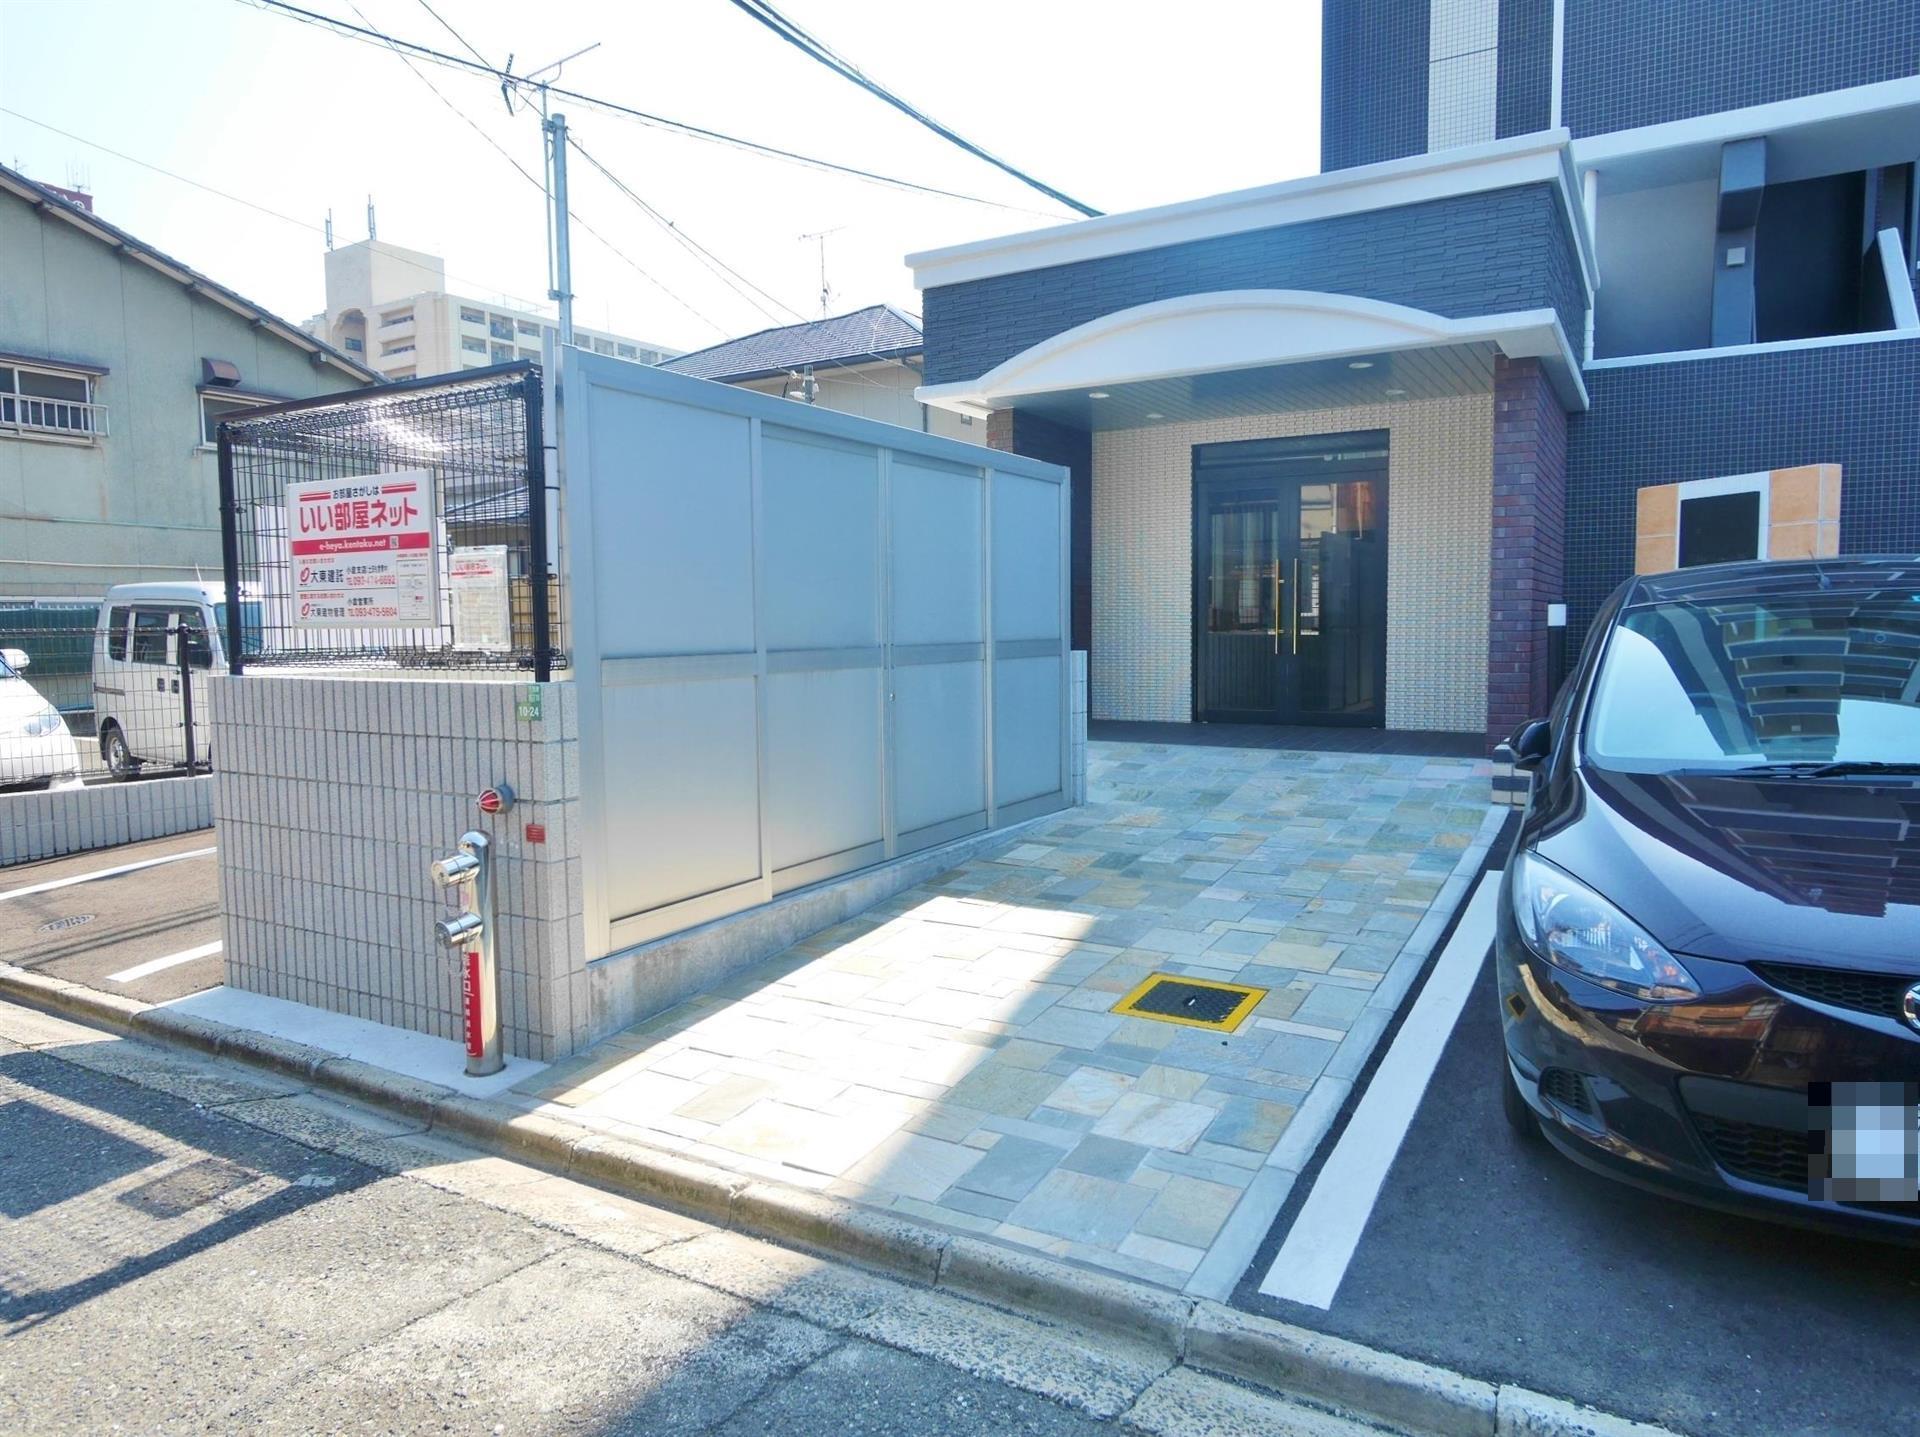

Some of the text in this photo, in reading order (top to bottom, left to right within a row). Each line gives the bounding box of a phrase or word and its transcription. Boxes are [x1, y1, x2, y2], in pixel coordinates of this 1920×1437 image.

[333, 485, 380, 500] お部屋さがしは
[300, 497, 418, 533] いい部屋ネット
[310, 569, 344, 583] 大東建託
